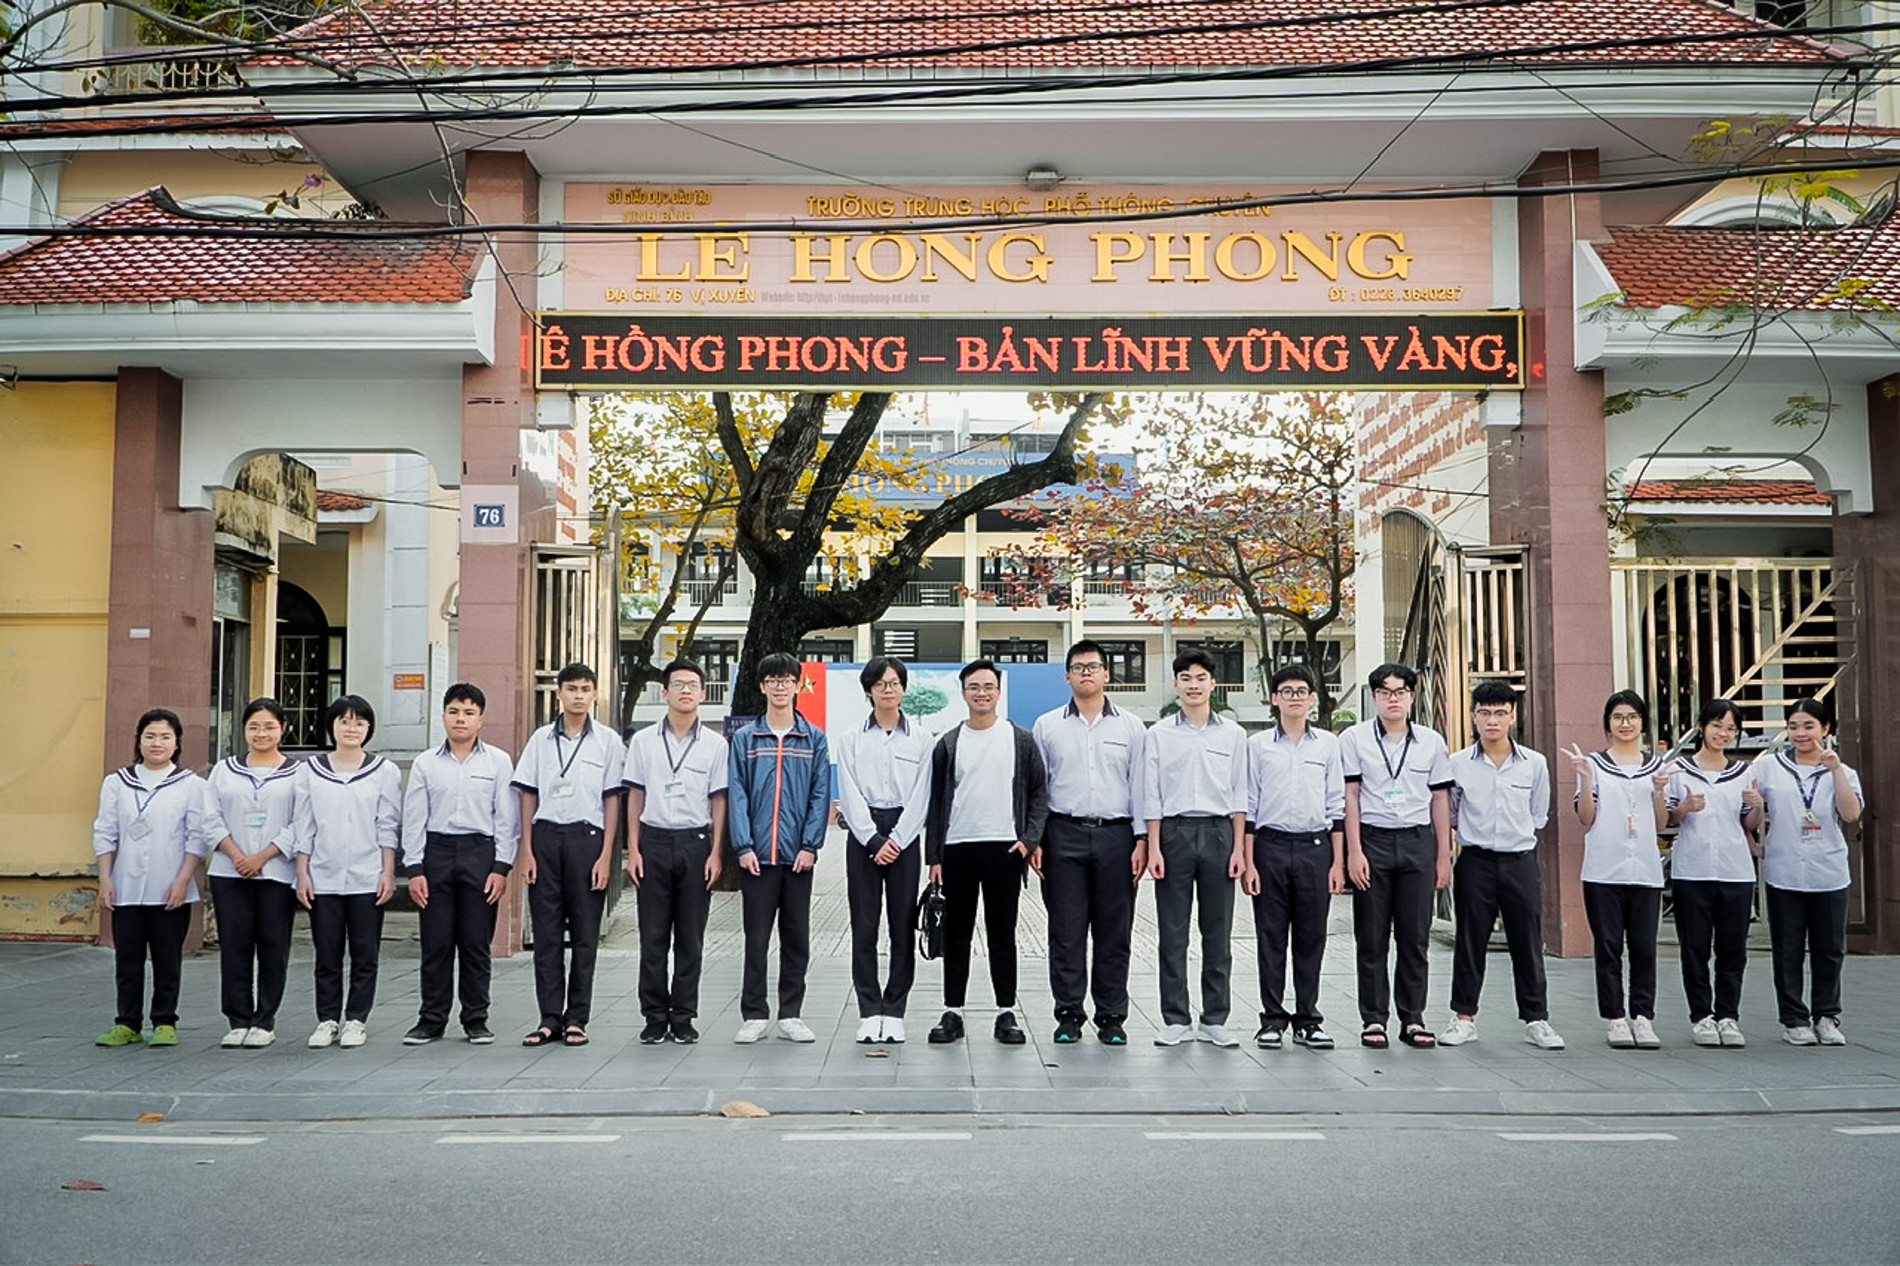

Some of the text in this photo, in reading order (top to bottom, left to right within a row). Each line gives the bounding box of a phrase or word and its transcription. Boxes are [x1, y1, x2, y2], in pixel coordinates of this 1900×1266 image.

[903, 197, 972, 217] TRUNG
[1089, 230, 1413, 283] PHONG
[665, 287, 683, 302] 76
[708, 284, 757, 304] XUYÊN
[581, 324, 726, 372] HỒNG
[738, 335, 908, 372] PHONG
[956, 326, 1062, 373] BẢN
[1072, 327, 1191, 373] LĨNH
[1360, 325, 1518, 378] VÀNG,
[479, 508, 500, 525] 76
